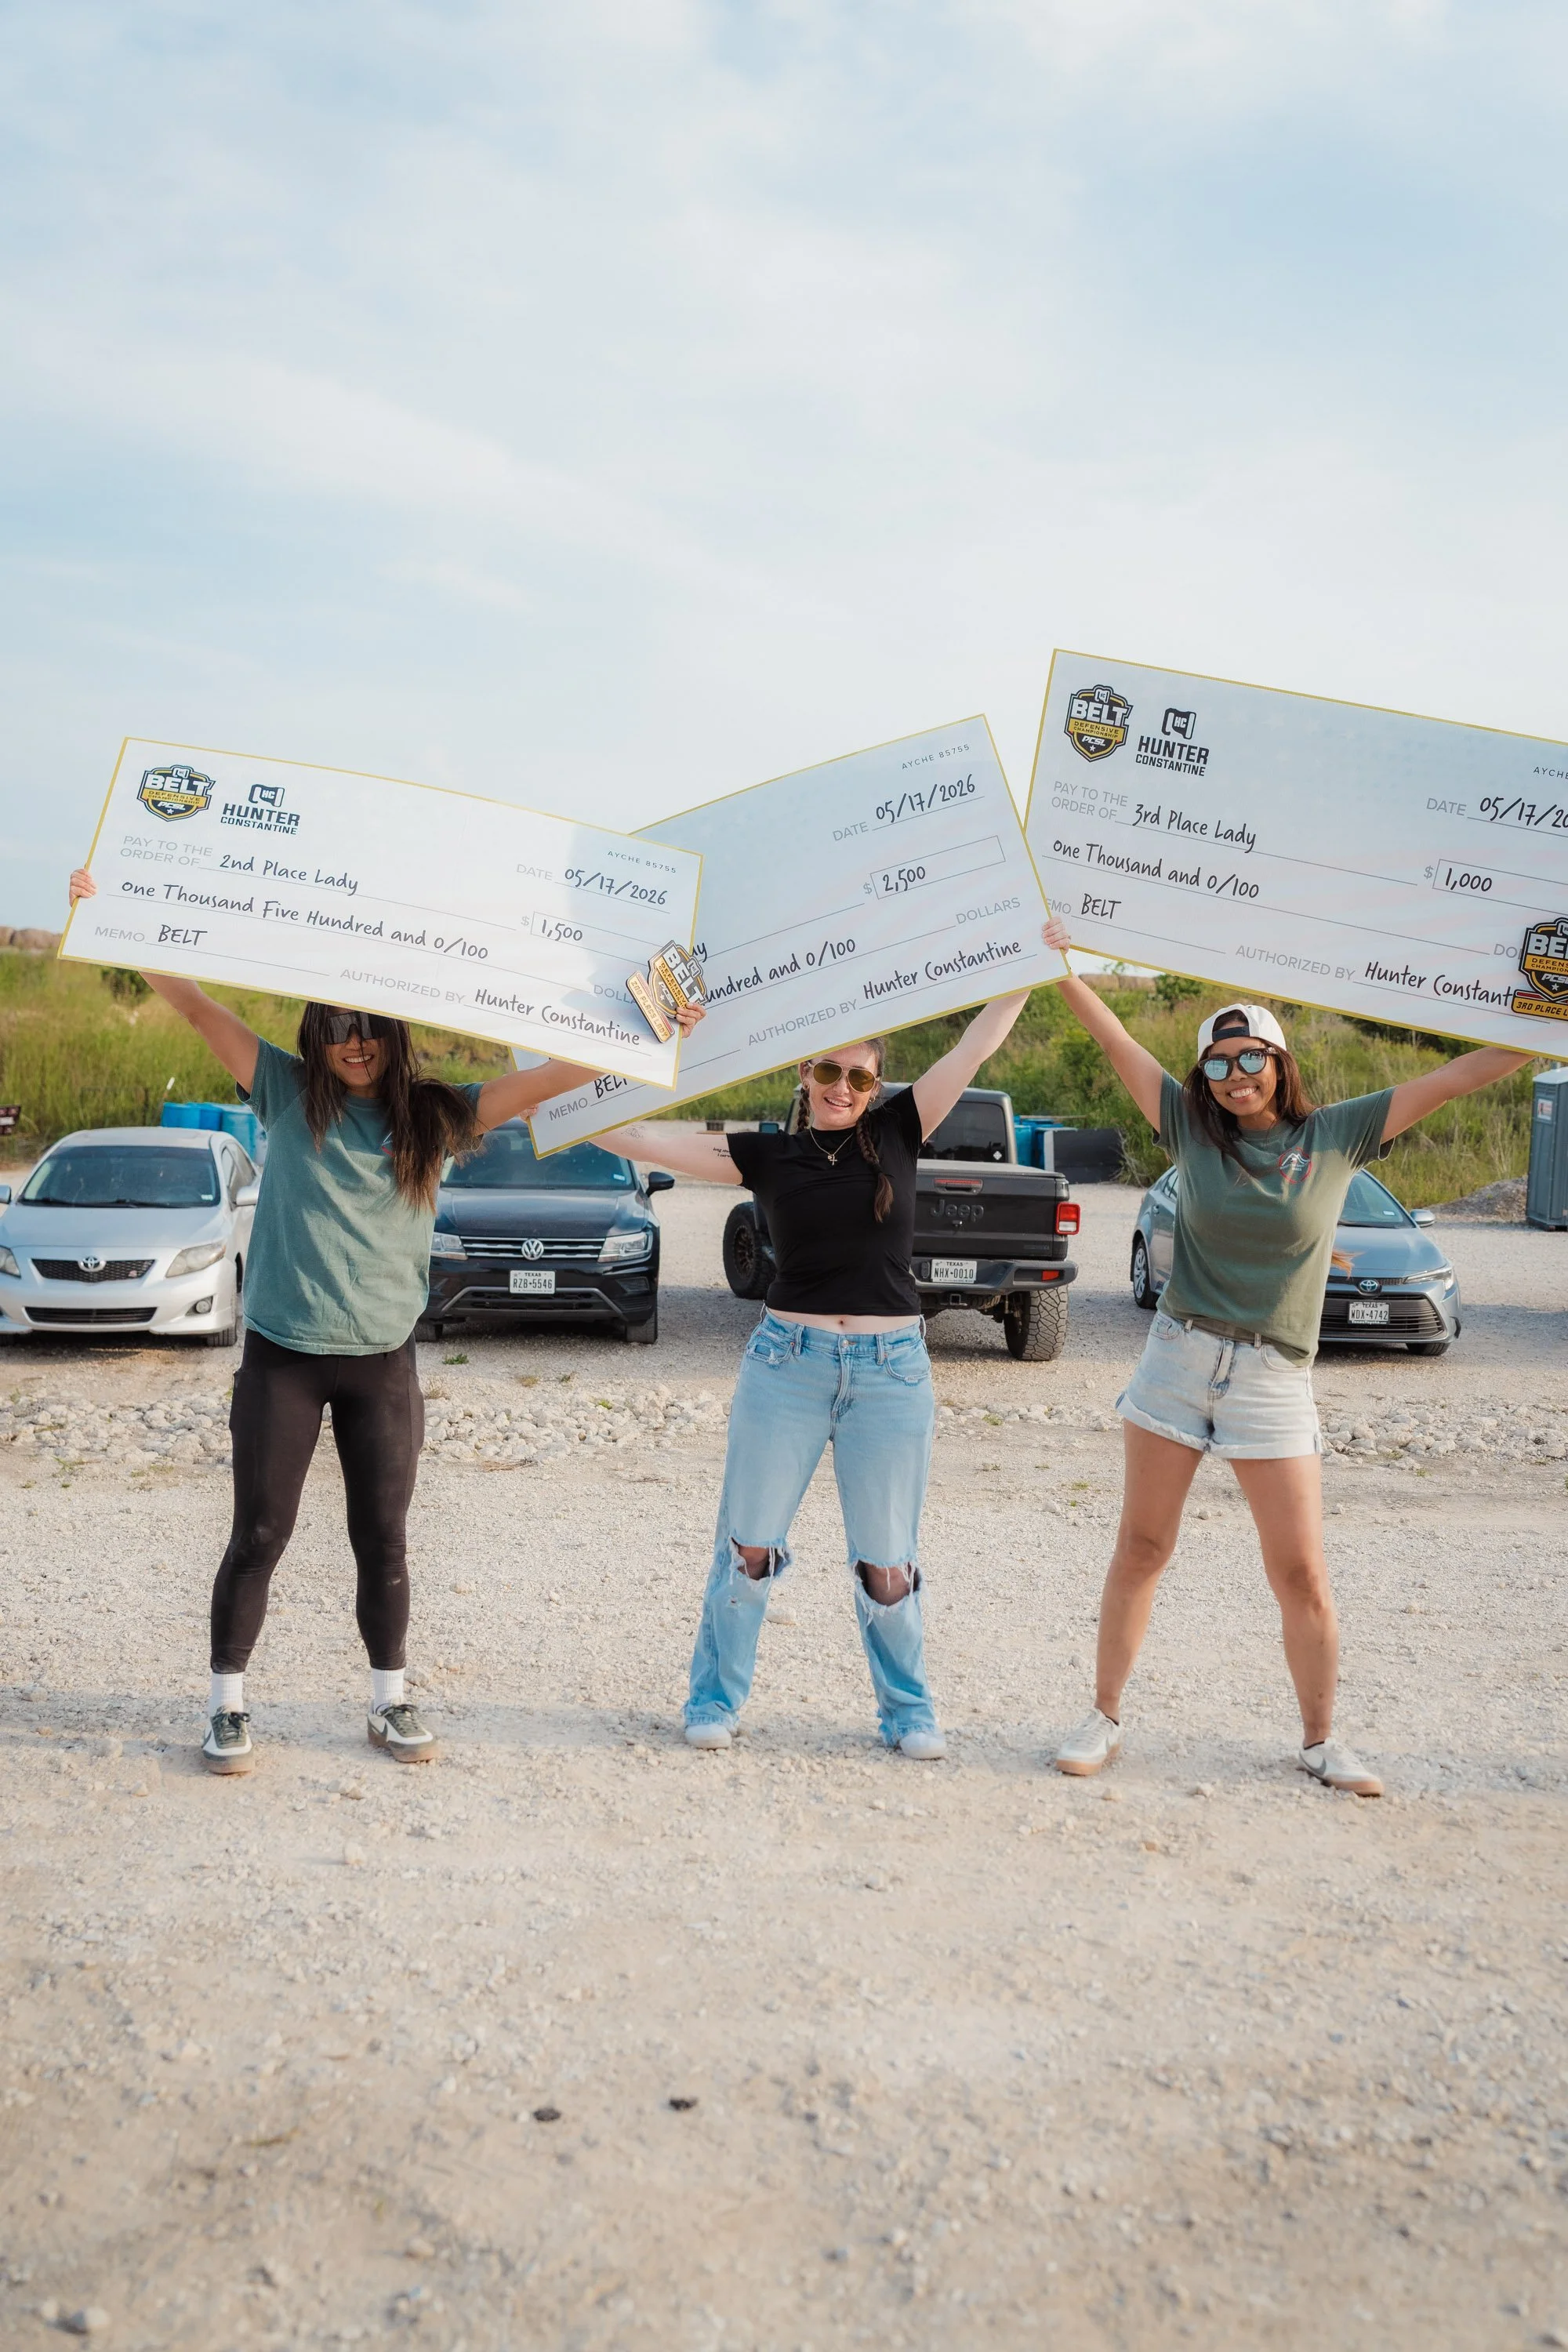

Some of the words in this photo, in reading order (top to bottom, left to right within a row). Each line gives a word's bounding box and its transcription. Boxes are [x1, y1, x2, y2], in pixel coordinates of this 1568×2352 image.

[1071, 699, 1127, 727] BELT
[1174, 716, 1187, 728] HC
[1073, 726, 1118, 738] CHAMPIONSHIP
[1074, 720, 1119, 734] DEFENSIVE
[1082, 735, 1105, 746] PCSL
[1138, 735, 1209, 764] HUNTER
[902, 753, 935, 770] AYCHE
[938, 744, 970, 758] 85755
[1135, 753, 1206, 776] CONSTANTINE
[144, 774, 210, 796] BELT
[148, 790, 201, 802] DEFENSIVE
[262, 789, 275, 799] HC
[1054, 781, 1077, 796] PAY
[1082, 786, 1098, 800] TO
[1102, 792, 1128, 807] THE
[147, 794, 200, 804] CHAMPIONSHIP
[158, 801, 186, 811] PCSL
[833, 822, 869, 841] DATE
[876, 774, 975, 823] 05/17/2026
[1426, 798, 1467, 816] DATE
[220, 816, 298, 835] CONSTANTINE
[223, 803, 300, 826] HUNTER
[1051, 797, 1095, 815] ORDER
[1098, 808, 1117, 820] OF
[1132, 804, 1161, 826] 3rd
[1167, 810, 1208, 835] Place
[1214, 820, 1256, 853] Lady
[123, 836, 153, 848] PAY
[158, 840, 177, 851] TO
[183, 844, 213, 857] THE
[120, 848, 174, 863] ORDER
[178, 856, 201, 866] OF
[220, 855, 254, 871] 2nd
[263, 860, 307, 880] Place
[314, 869, 358, 896] Lady
[608, 851, 641, 863] AYCHE
[645, 861, 677, 873] 85755
[1053, 840, 1080, 858] one
[1086, 844, 1163, 877] Thousand
[1168, 867, 1201, 886] and
[1207, 874, 1259, 898] 0/100
[517, 864, 553, 880] DATE
[564, 869, 667, 905] 05/17/2026
[863, 882, 873, 895] $
[883, 866, 926, 891] 2,500
[1423, 866, 1434, 879] $
[1445, 868, 1492, 891] 1,000
[1081, 893, 1122, 919] BELT
[122, 882, 155, 896] one
[163, 884, 254, 912] Thousand
[263, 901, 299, 920] Five
[307, 910, 383, 937] Hundred
[391, 930, 426, 946] and
[434, 938, 488, 959] 0/100
[521, 916, 530, 927] $
[542, 919, 583, 941] 1,500
[94, 926, 145, 942] MEMO
[158, 924, 208, 946] BELT
[704, 967, 763, 1006] undred
[769, 953, 800, 980] and
[806, 938, 855, 967] 0/100
[956, 897, 1021, 924] DOLLARS
[662, 946, 706, 1004] BELT
[1236, 945, 1330, 975] AUTHORIZED
[1334, 967, 1356, 980] BY
[1365, 961, 1427, 989] Hunter
[1433, 975, 1513, 1007] Constant
[1531, 964, 1568, 974] CHAMPION
[660, 962, 687, 1005] DEFENSIV
[748, 1007, 836, 1046] AUTHORIZED
[839, 999, 858, 1014] BY
[863, 970, 918, 1000] Hunter
[924, 942, 1022, 981] Constantine
[339, 969, 441, 998] AUTHORIZED
[445, 992, 465, 1004] BY
[475, 989, 535, 1015] Hunter
[541, 1005, 640, 1045] Constantine
[1516, 1001, 1534, 1011] 3RD
[1534, 1004, 1563, 1016] PLACE
[549, 1098, 588, 1121] MEMO
[930, 1200, 984, 1222] Jeep
